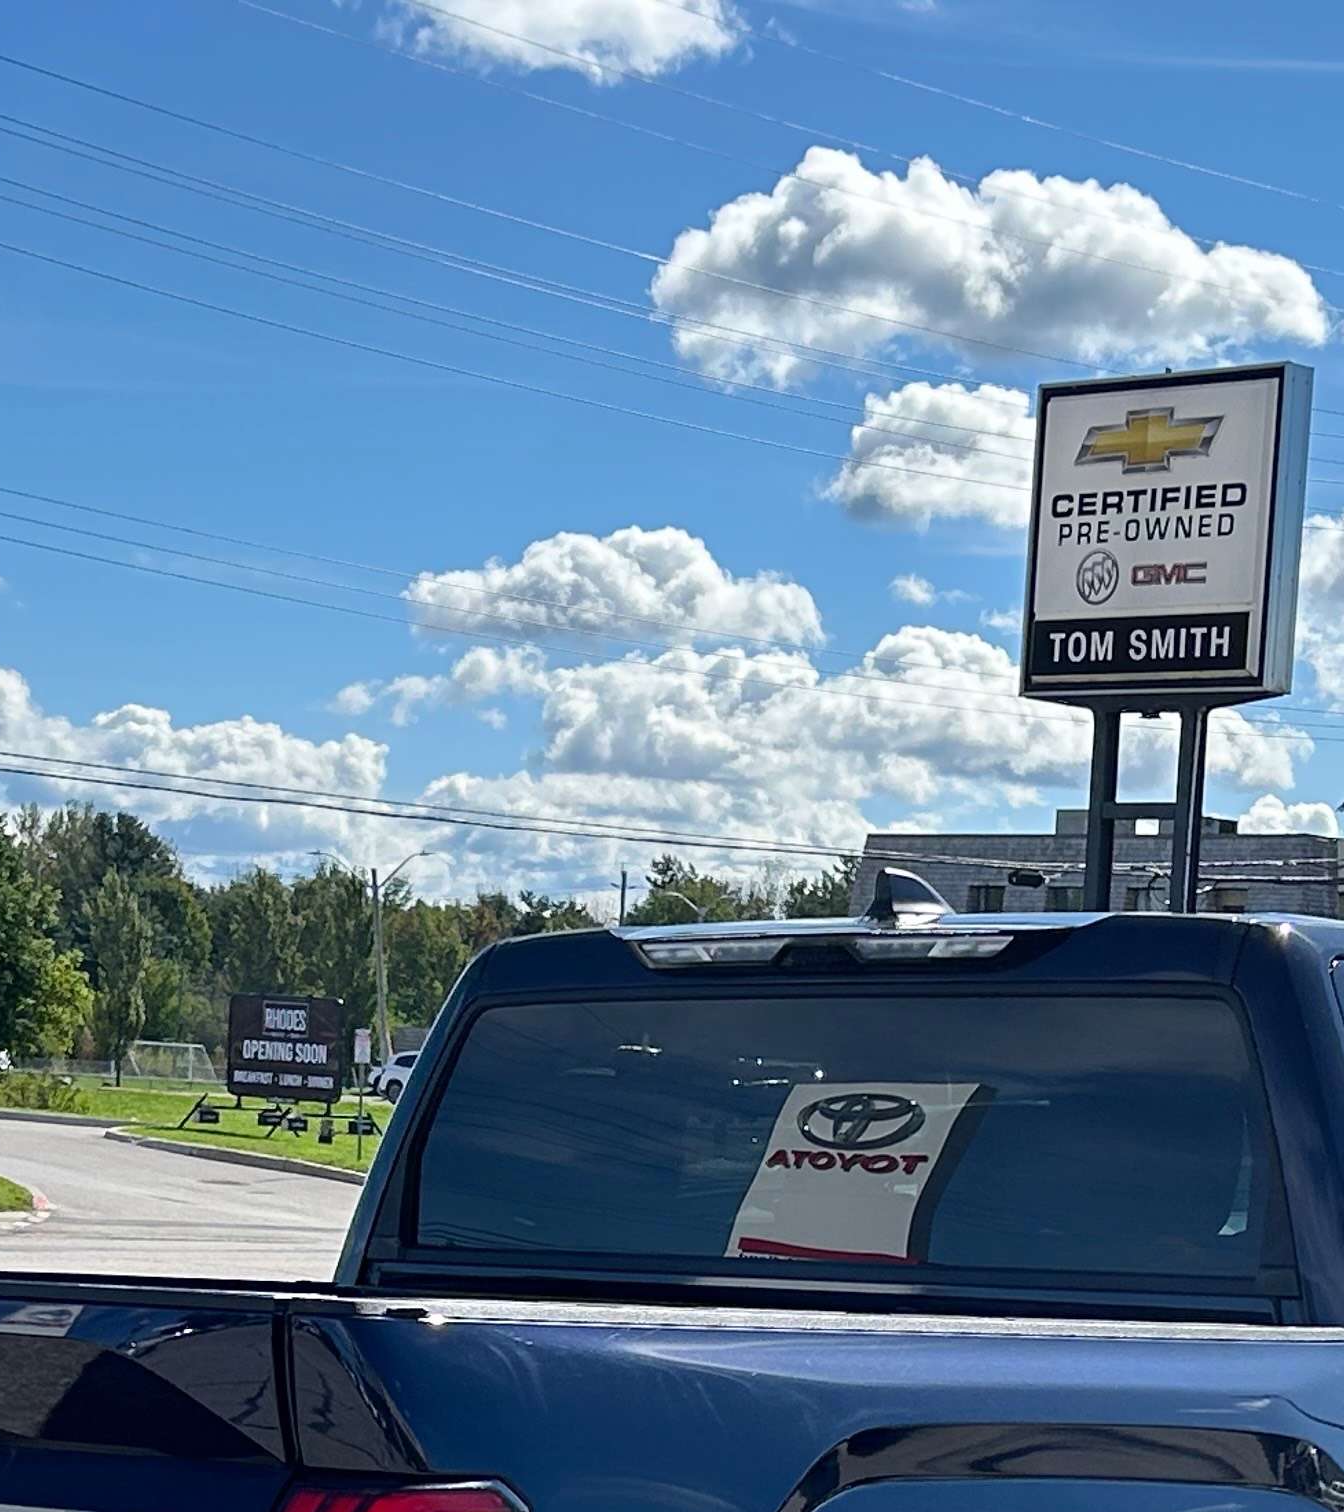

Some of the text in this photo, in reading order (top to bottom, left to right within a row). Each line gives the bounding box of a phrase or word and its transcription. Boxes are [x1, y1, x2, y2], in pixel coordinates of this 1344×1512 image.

[1051, 482, 1248, 519] CERTIFIED
[1057, 513, 1235, 546] PRE-OWNED
[1131, 562, 1208, 587] GMC
[1049, 625, 1231, 663] TOM SMITH
[242, 1039, 294, 1063] OPENING
[295, 1042, 328, 1065] SOON
